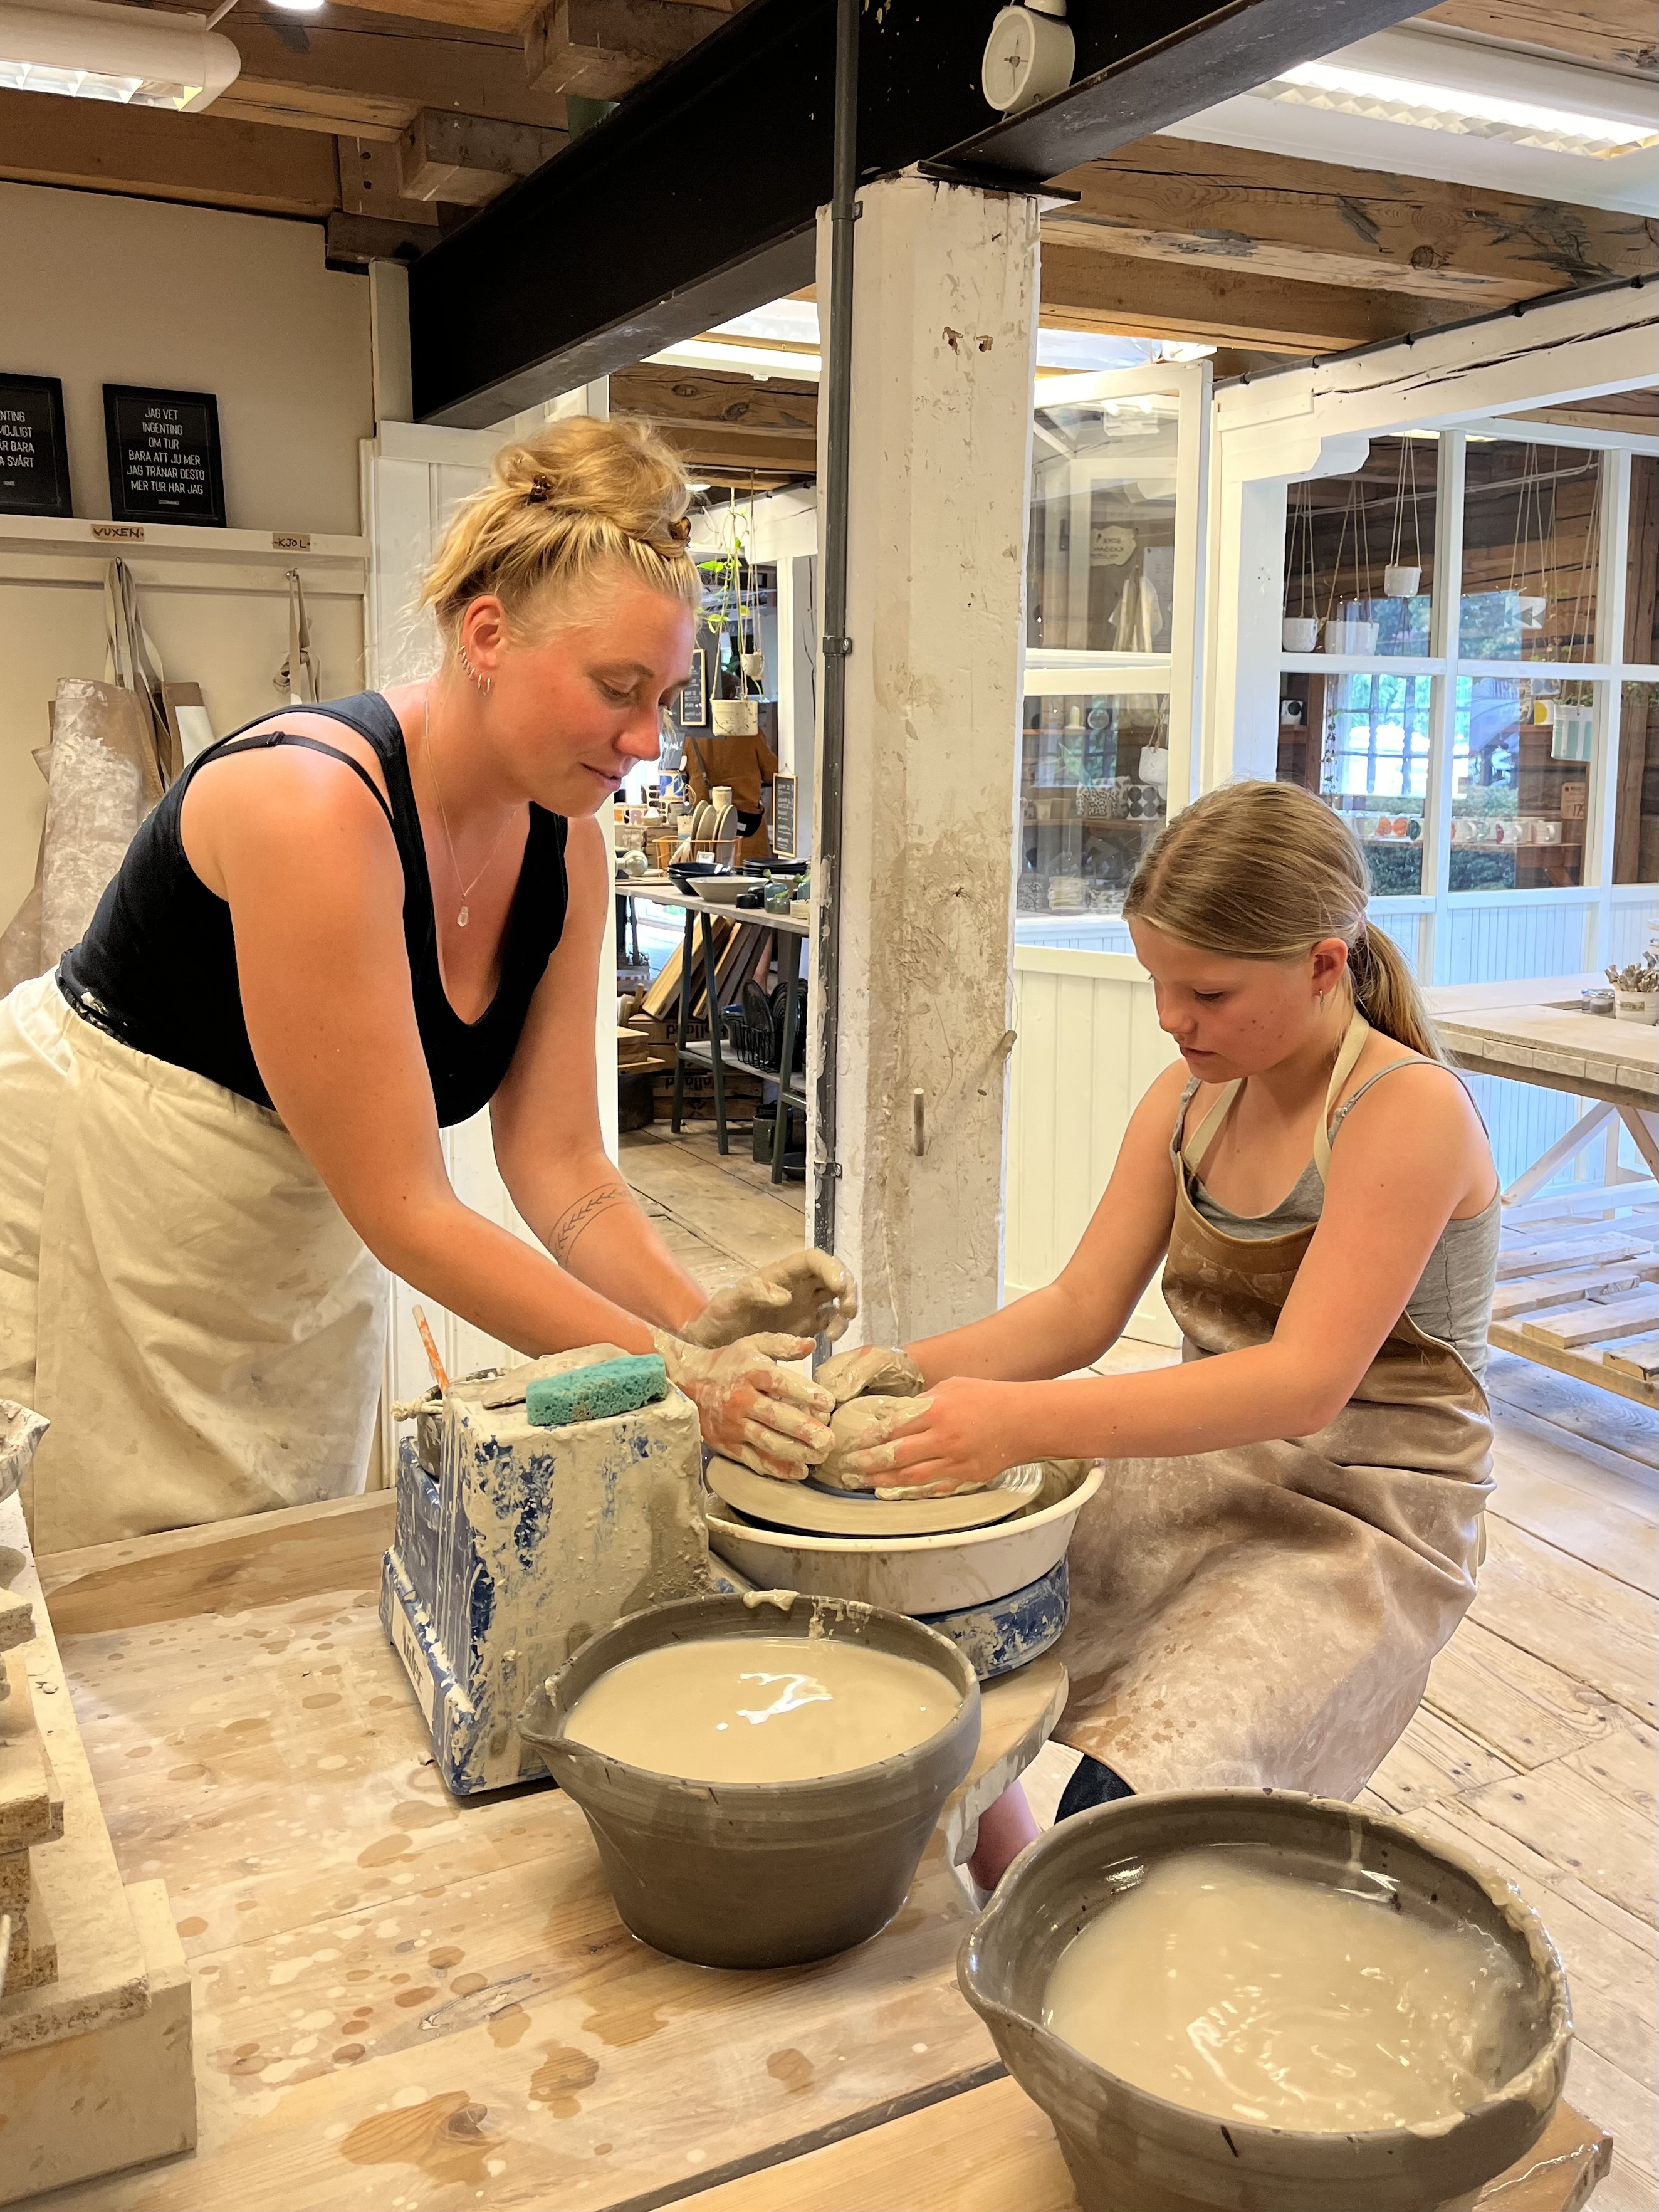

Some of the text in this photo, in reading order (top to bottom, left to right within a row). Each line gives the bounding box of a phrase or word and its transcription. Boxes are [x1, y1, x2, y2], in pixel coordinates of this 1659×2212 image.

[144, 407, 178, 421] JAG VET
[142, 421, 183, 436] INGENTING
[10, 440, 35, 453] BARA
[148, 436, 179, 449] OM TUR
[7, 454, 34, 468] SVÅRT
[128, 449, 201, 466] BARA ATT JU MER
[127, 465, 205, 481] JAG TRÄNAR DESTO
[130, 480, 204, 495] MER TUR HAR JAG
